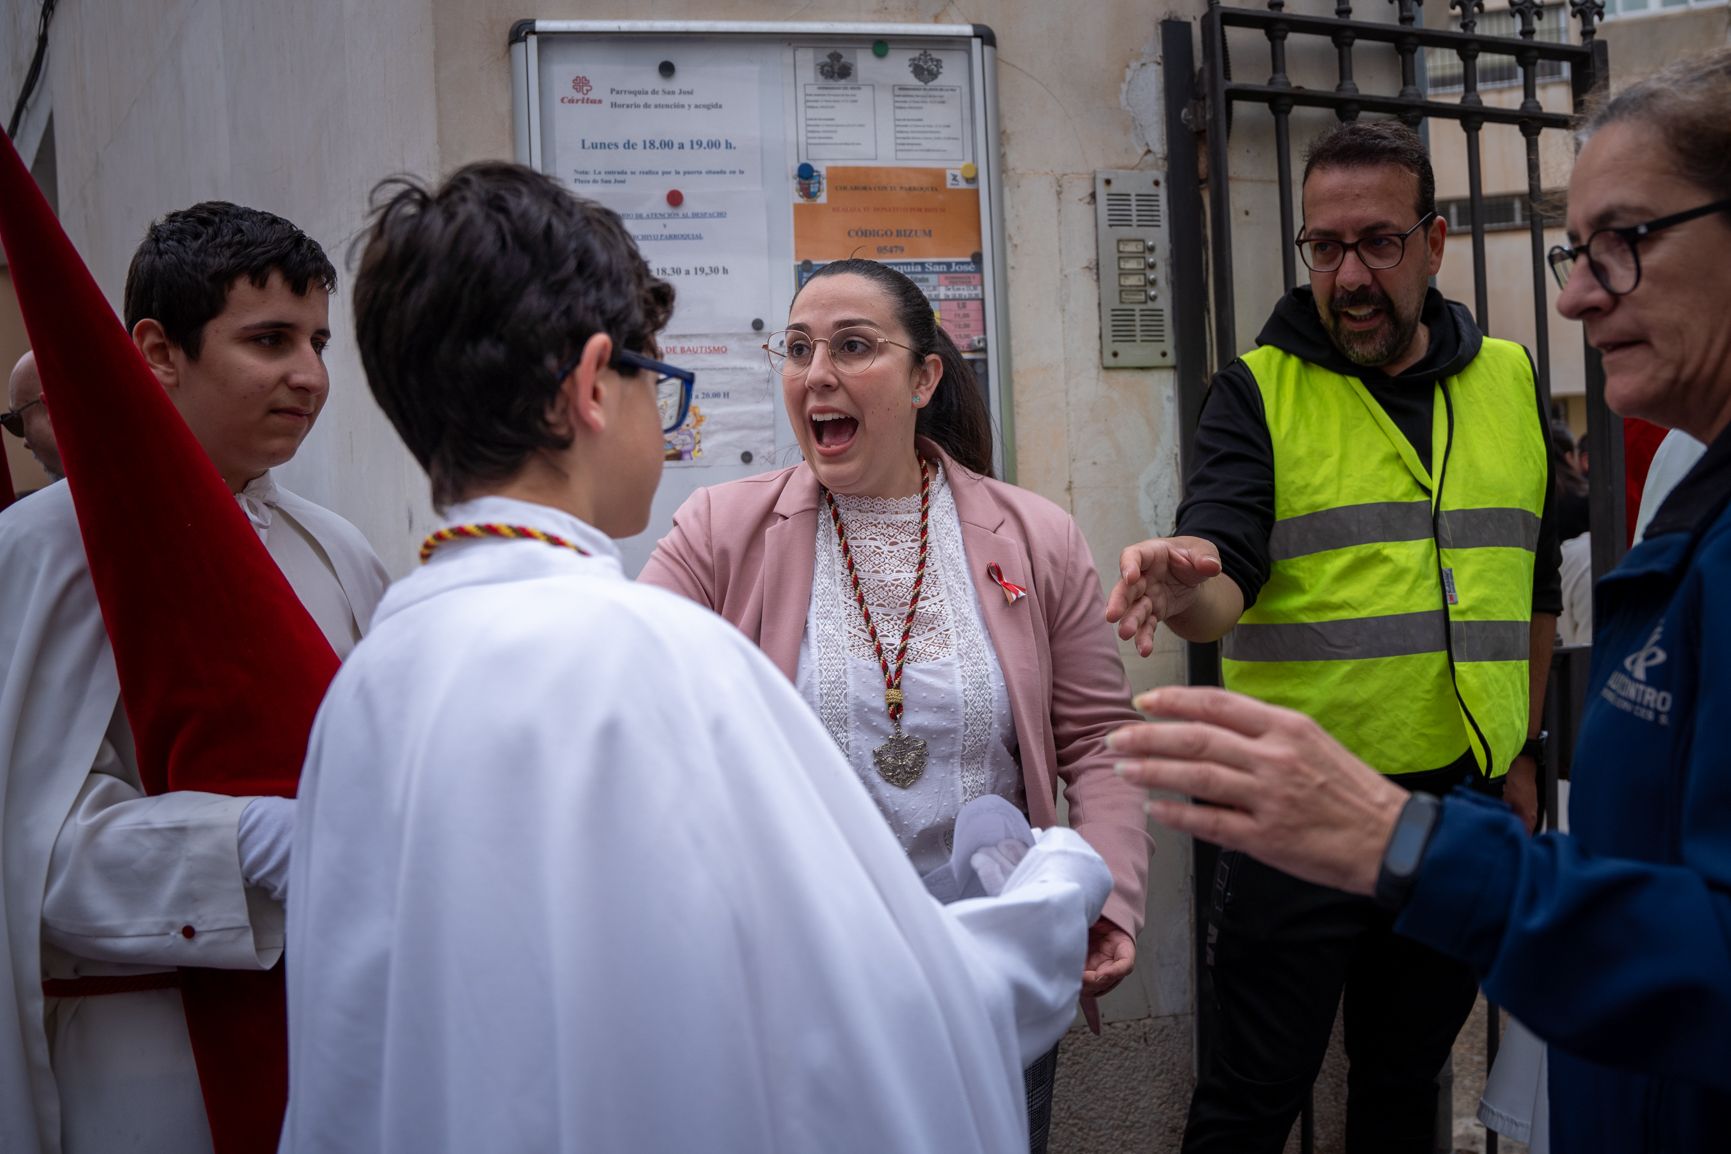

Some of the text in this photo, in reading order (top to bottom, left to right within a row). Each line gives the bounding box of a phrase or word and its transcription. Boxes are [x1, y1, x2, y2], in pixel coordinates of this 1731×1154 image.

[610, 88, 694, 97] Parroquia de San José
[654, 101, 686, 109] atención
[694, 102, 723, 111] acogida
[581, 138, 737, 150] Lunes de 18.00 a 19.00 h.
[847, 227, 932, 238] CÓDIGO BIZUM
[723, 265, 728, 274] h
[924, 262, 948, 272] San
[950, 262, 976, 272] José
[665, 346, 679, 354] DE
[680, 345, 728, 354] BAUTISMO
